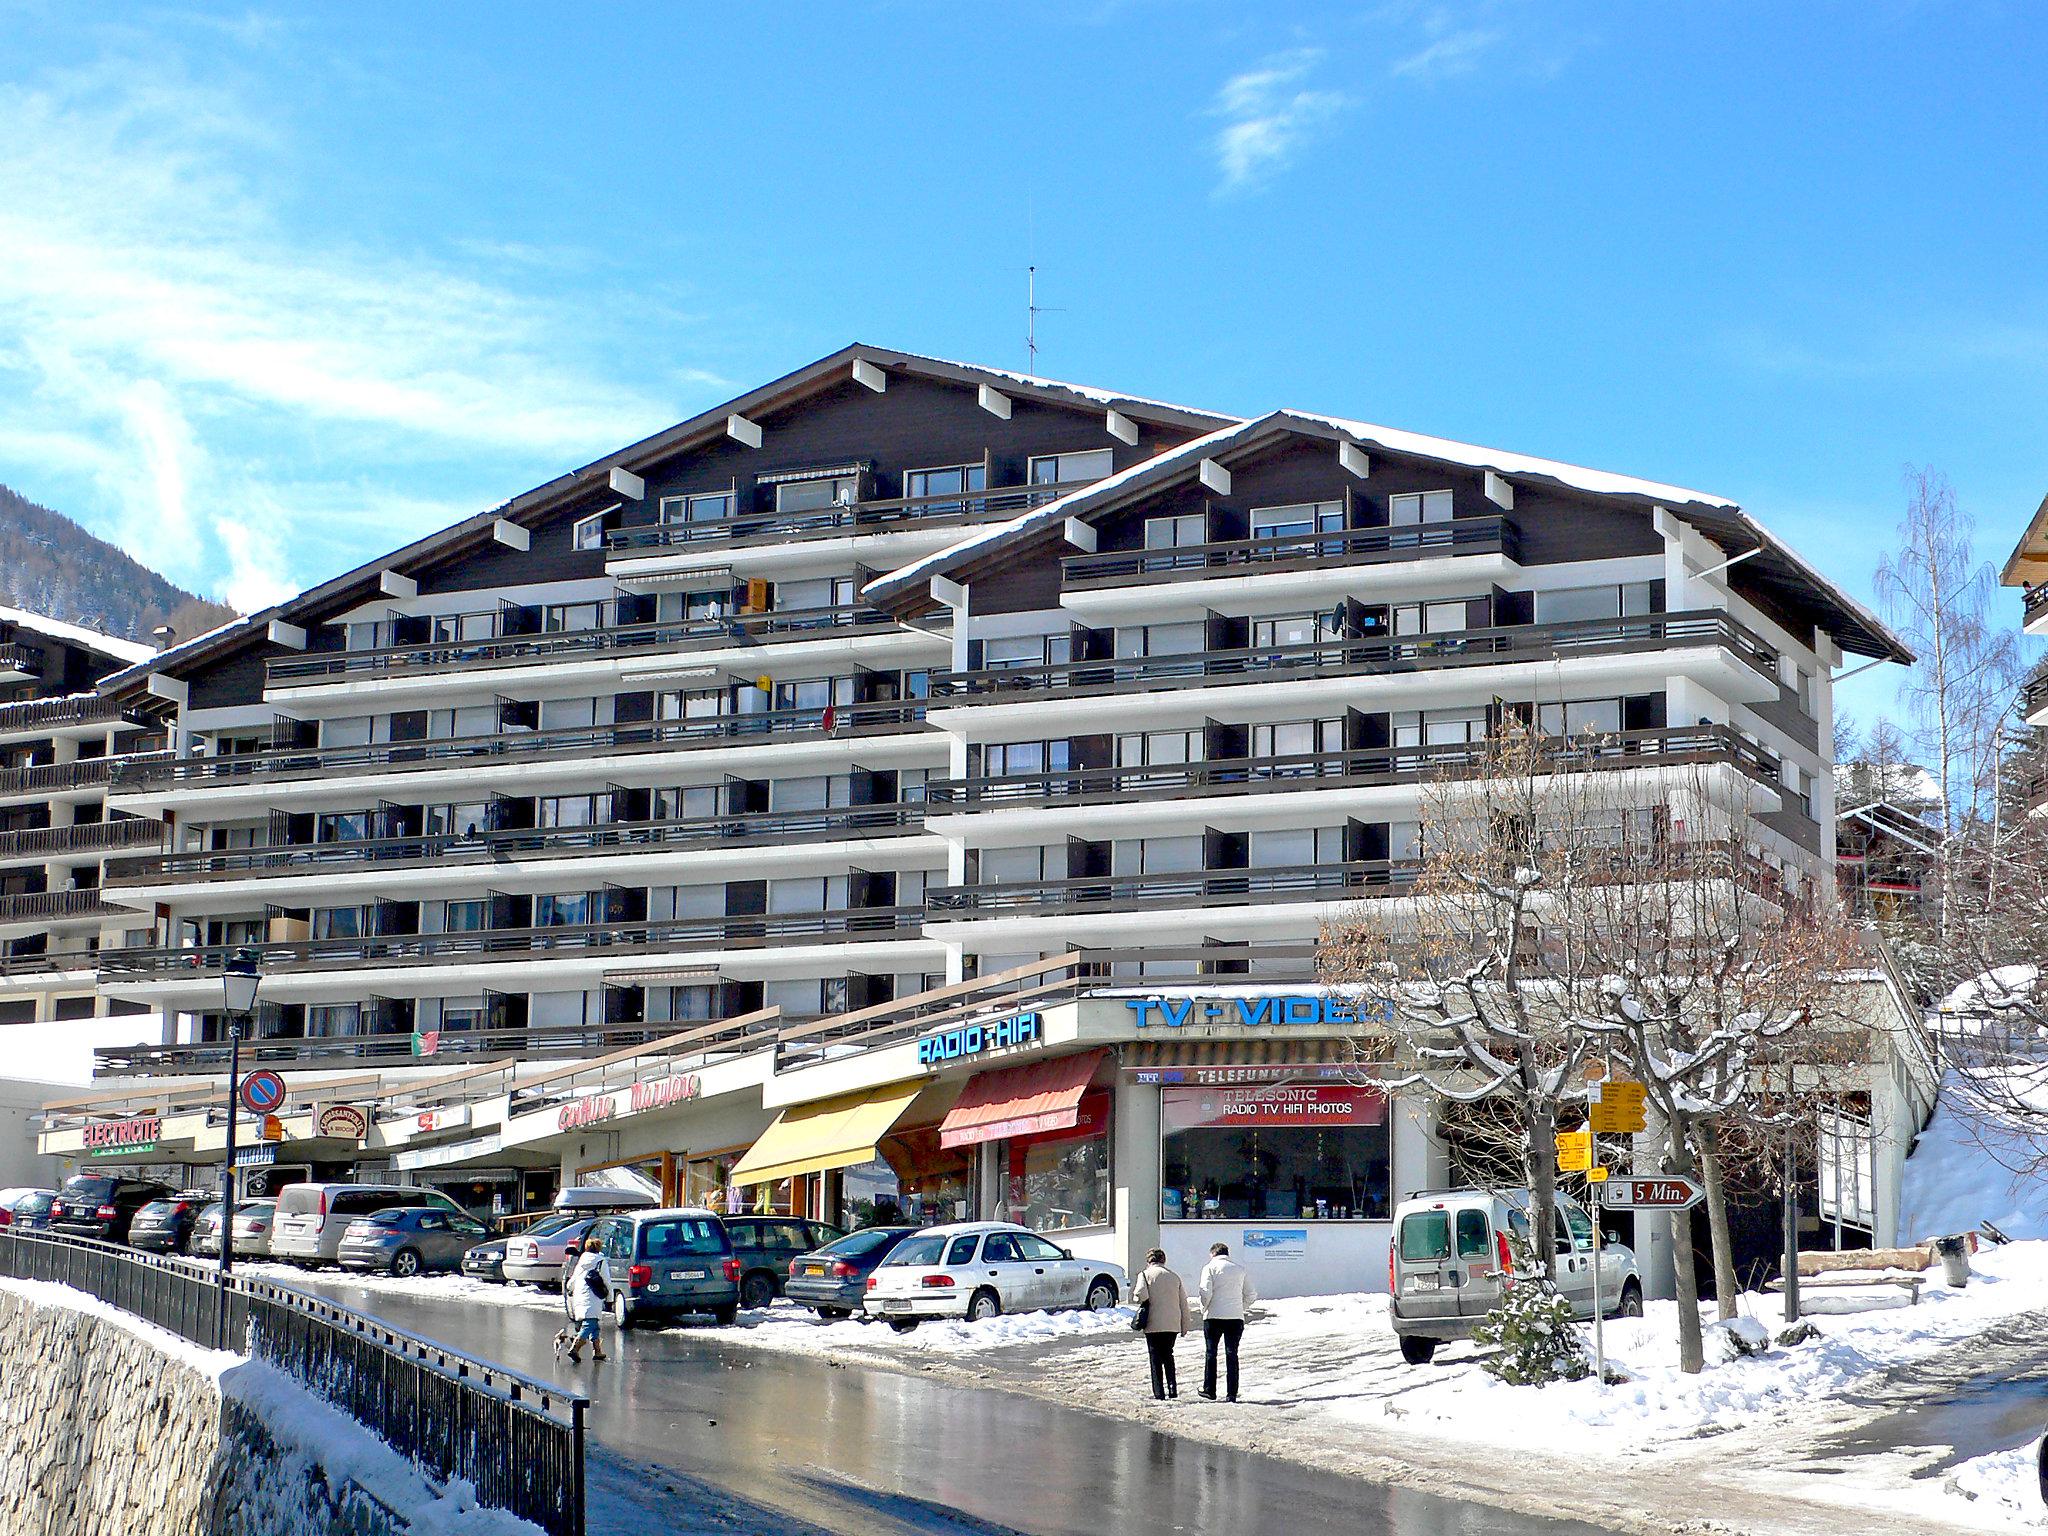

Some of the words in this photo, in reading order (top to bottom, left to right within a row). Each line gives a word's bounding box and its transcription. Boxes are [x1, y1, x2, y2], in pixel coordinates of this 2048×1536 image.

[1126, 998, 1193, 1027] TV
[1236, 997, 1395, 1025] VIDEO
[1198, 1069, 1303, 1083] TELEFUNKEN
[1223, 1089, 1317, 1102] TELESONIC
[1223, 1104, 1257, 1115] RADIO
[1262, 1104, 1279, 1115] TV
[1283, 1104, 1303, 1114] HIFI
[1307, 1103, 1352, 1114] PHOTOS
[83, 1118, 159, 1146] ELECTRICITE
[1635, 1183, 1645, 1200] 5
[1649, 1183, 1684, 1200] Min.
